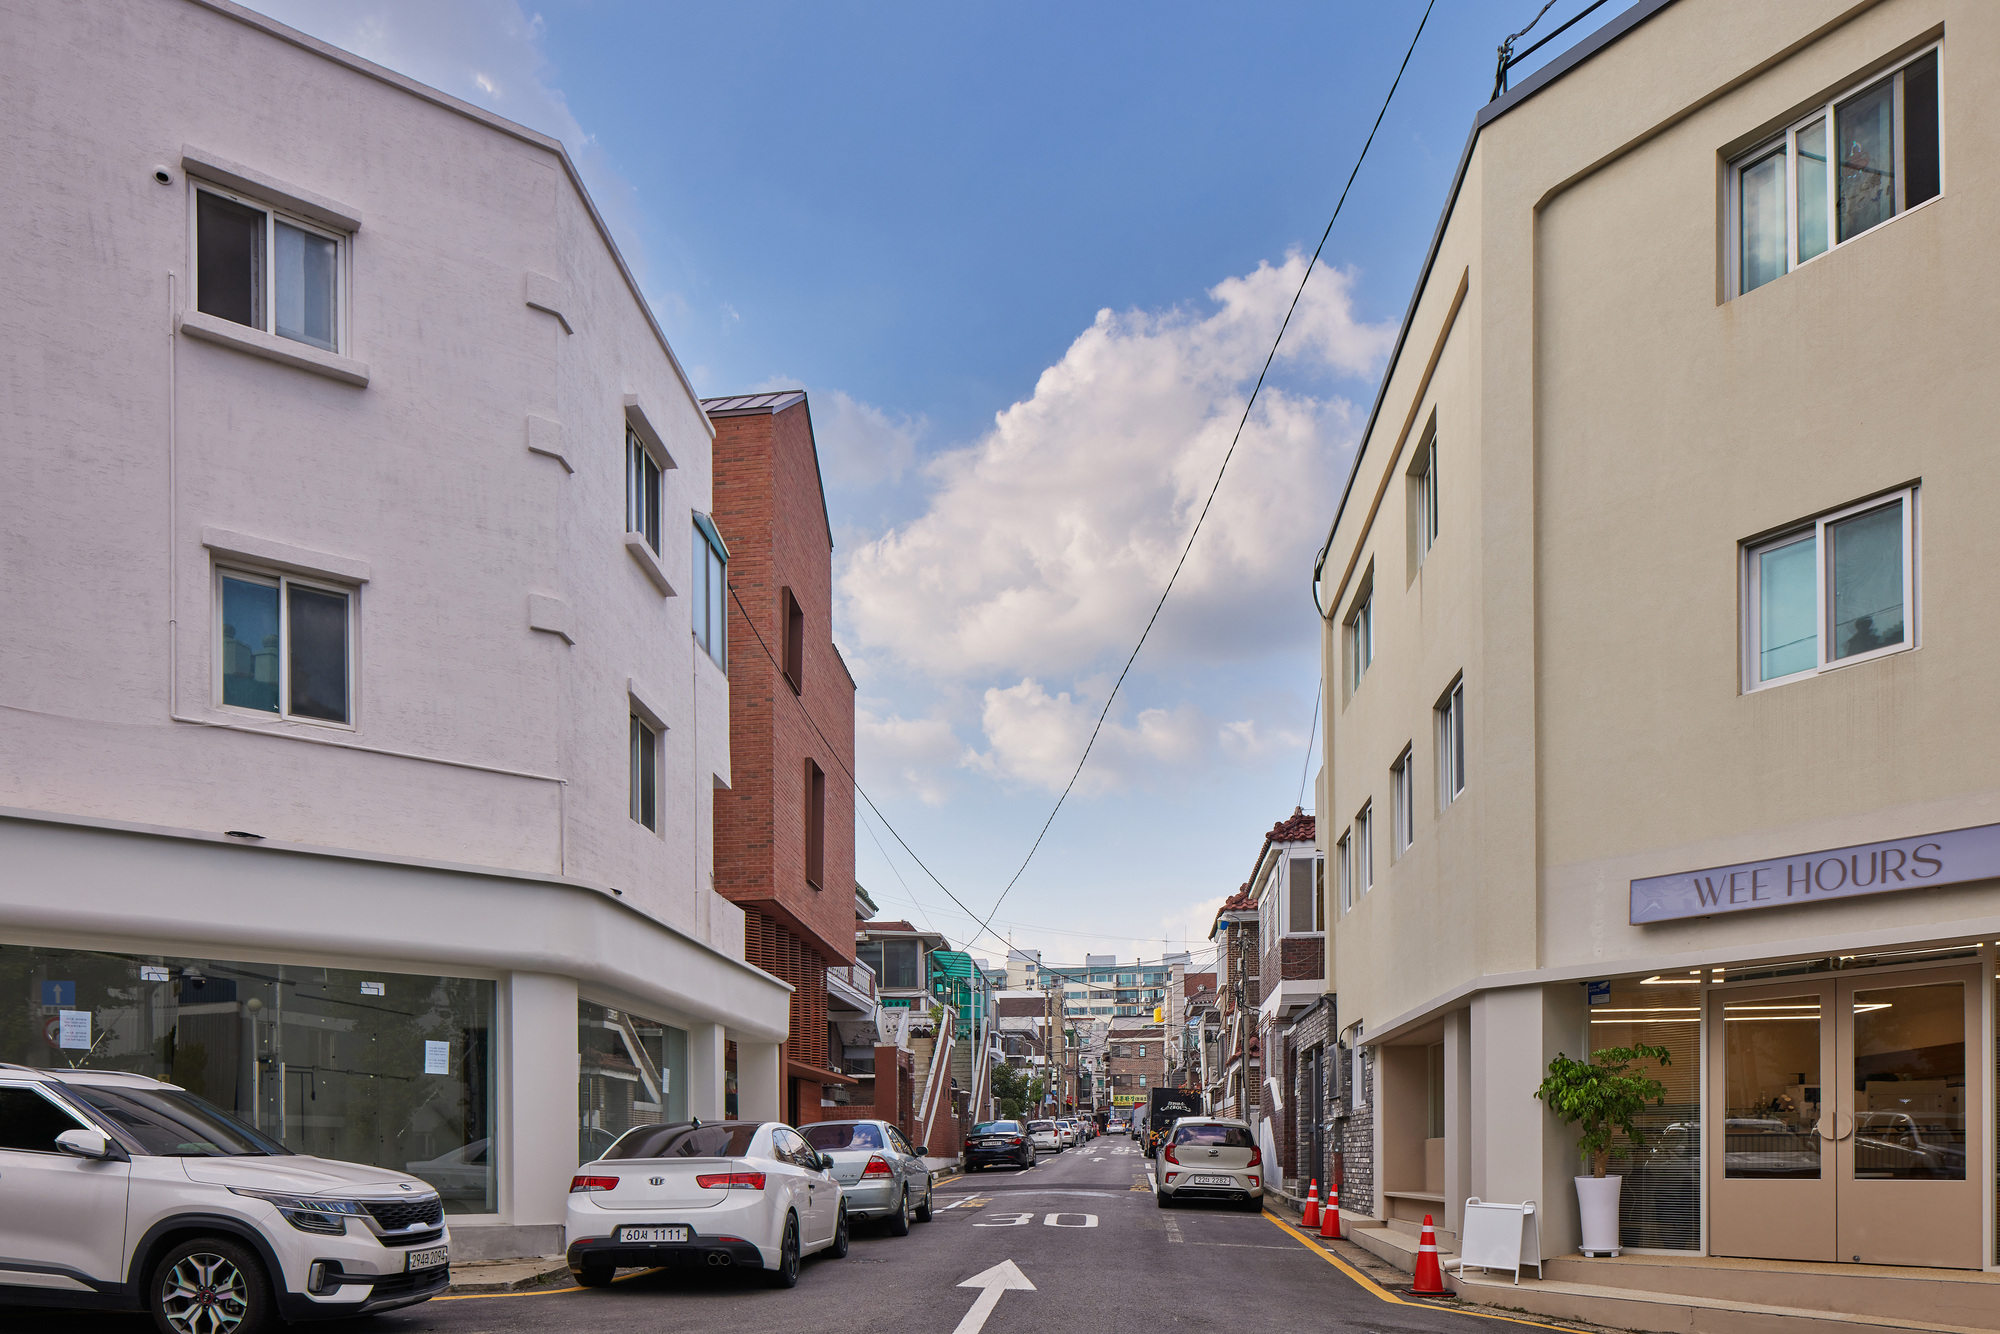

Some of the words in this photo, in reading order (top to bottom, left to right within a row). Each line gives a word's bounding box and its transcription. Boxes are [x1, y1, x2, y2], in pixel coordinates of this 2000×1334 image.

[1694, 868, 1771, 907] WEE
[1787, 843, 1942, 896] HOURS
[972, 1212, 1098, 1228] 30
[626, 1229, 648, 1240] 60서
[653, 1229, 681, 1240] 1111
[430, 1250, 445, 1264] 2094
